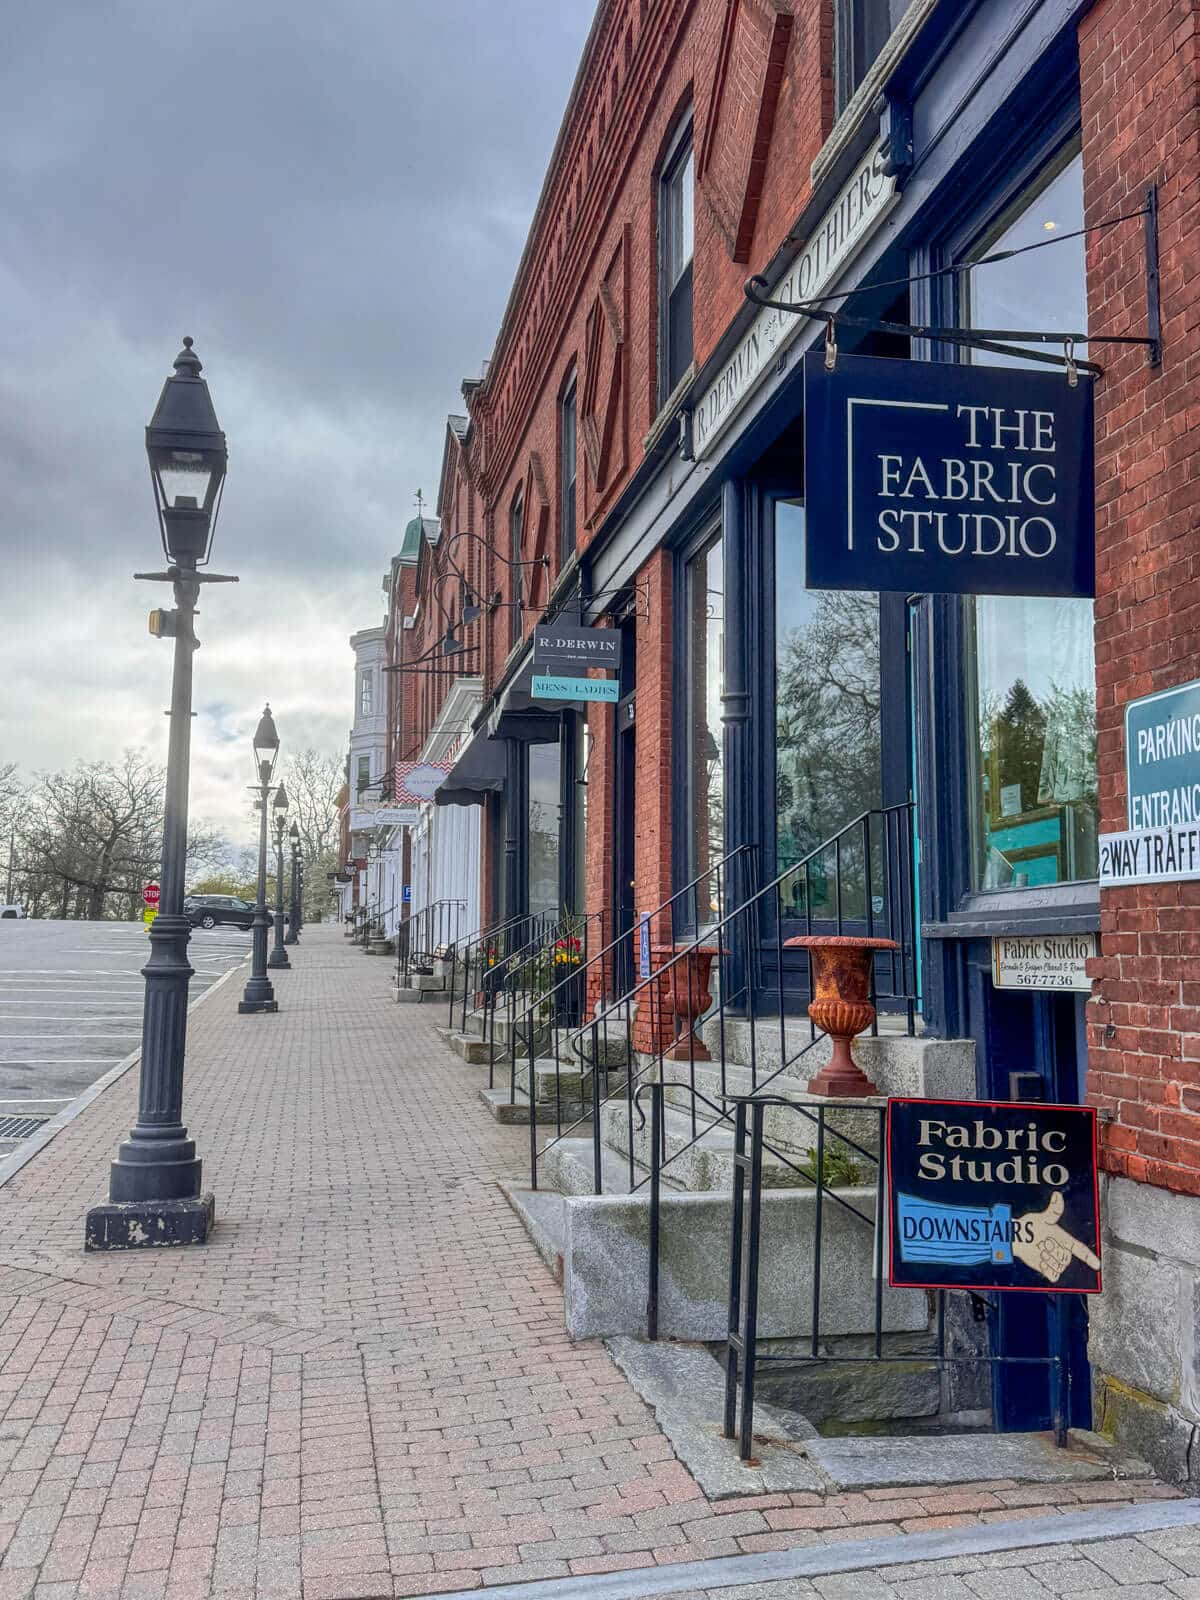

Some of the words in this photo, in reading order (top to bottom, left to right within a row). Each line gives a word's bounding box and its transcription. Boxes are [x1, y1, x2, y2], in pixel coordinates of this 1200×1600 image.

[778, 151, 884, 328] CLOTHIERS
[957, 404, 1056, 452] THE
[877, 454, 1056, 505] FABRIC
[877, 509, 1057, 558] STUDIO
[556, 638, 616, 651] DERWIN
[535, 682, 568, 692] MENS
[575, 683, 617, 695] LADIES
[1101, 837, 1141, 878] 2WAY
[1144, 829, 1200, 875] TRAFF
[143, 890, 160, 898] STOP
[1003, 938, 1041, 959] Fabric
[1044, 937, 1089, 959] Studio
[1016, 974, 1073, 986] 567-7736
[917, 1119, 1067, 1153] Fabric
[917, 1153, 1070, 1186] Studio
[903, 1216, 1034, 1244] DOWNSTAIRS
